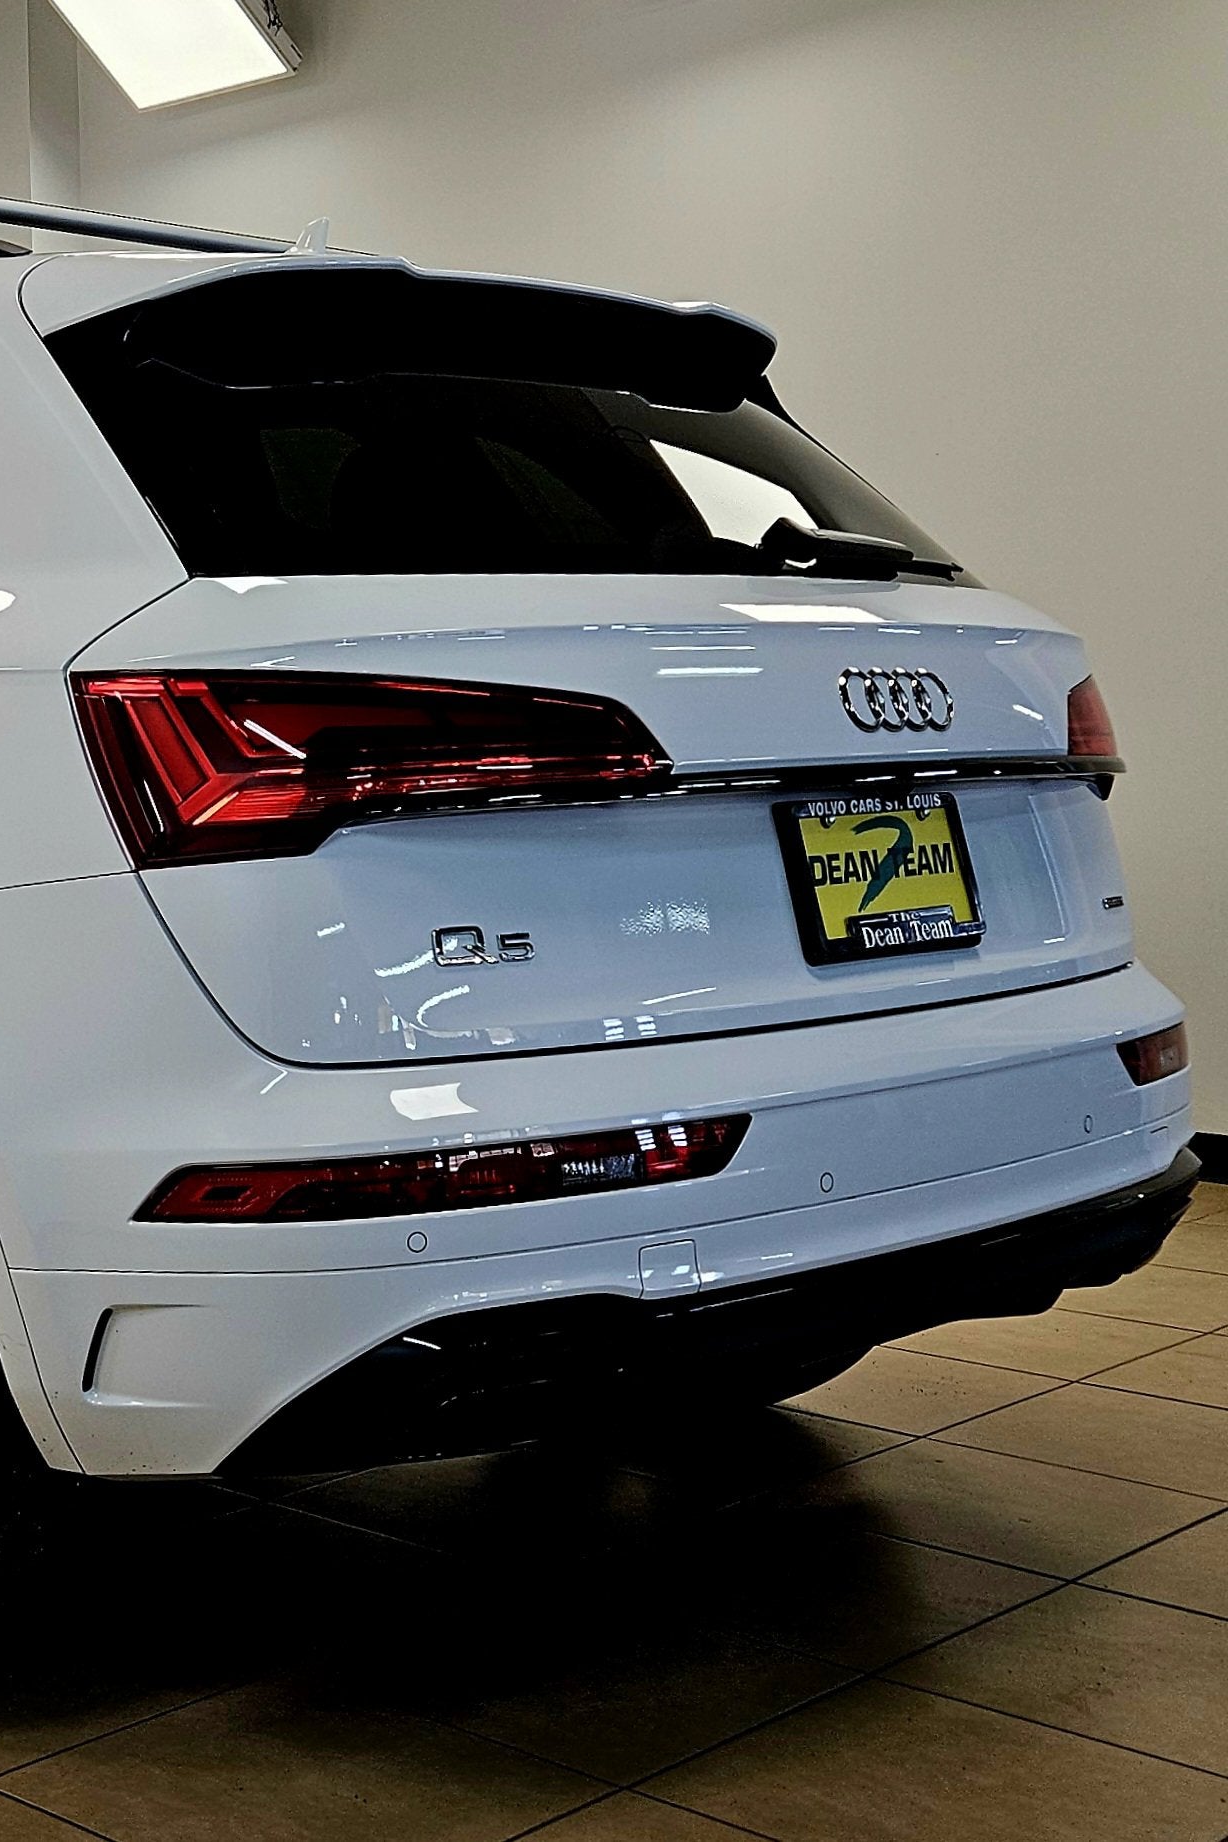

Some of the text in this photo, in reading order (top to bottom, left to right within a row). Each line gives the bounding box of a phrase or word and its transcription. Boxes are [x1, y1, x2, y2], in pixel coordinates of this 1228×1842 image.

[808, 801, 847, 816] VOLVO
[851, 798, 882, 814] CARS
[907, 794, 942, 809] LOUIS
[808, 850, 880, 887] DEAN
[887, 911, 921, 923] The
[431, 925, 536, 967] Q5
[862, 919, 954, 949] Dean Team
